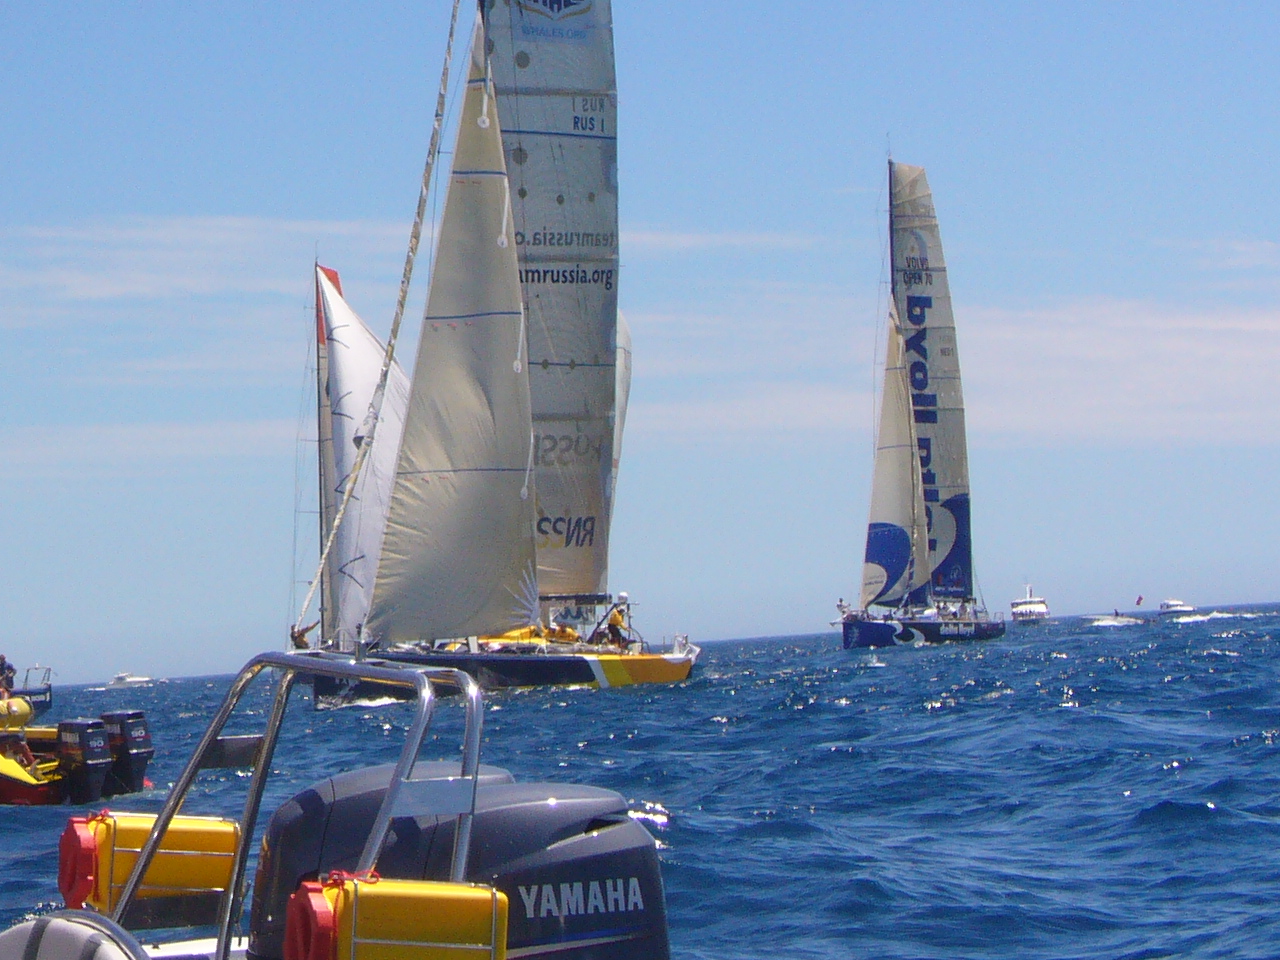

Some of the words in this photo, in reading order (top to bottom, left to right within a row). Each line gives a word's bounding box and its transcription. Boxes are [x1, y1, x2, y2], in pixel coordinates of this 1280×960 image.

[573, 115, 595, 131] RUS
[601, 117, 605, 132] 1
[518, 877, 644, 919] YAMAHA
